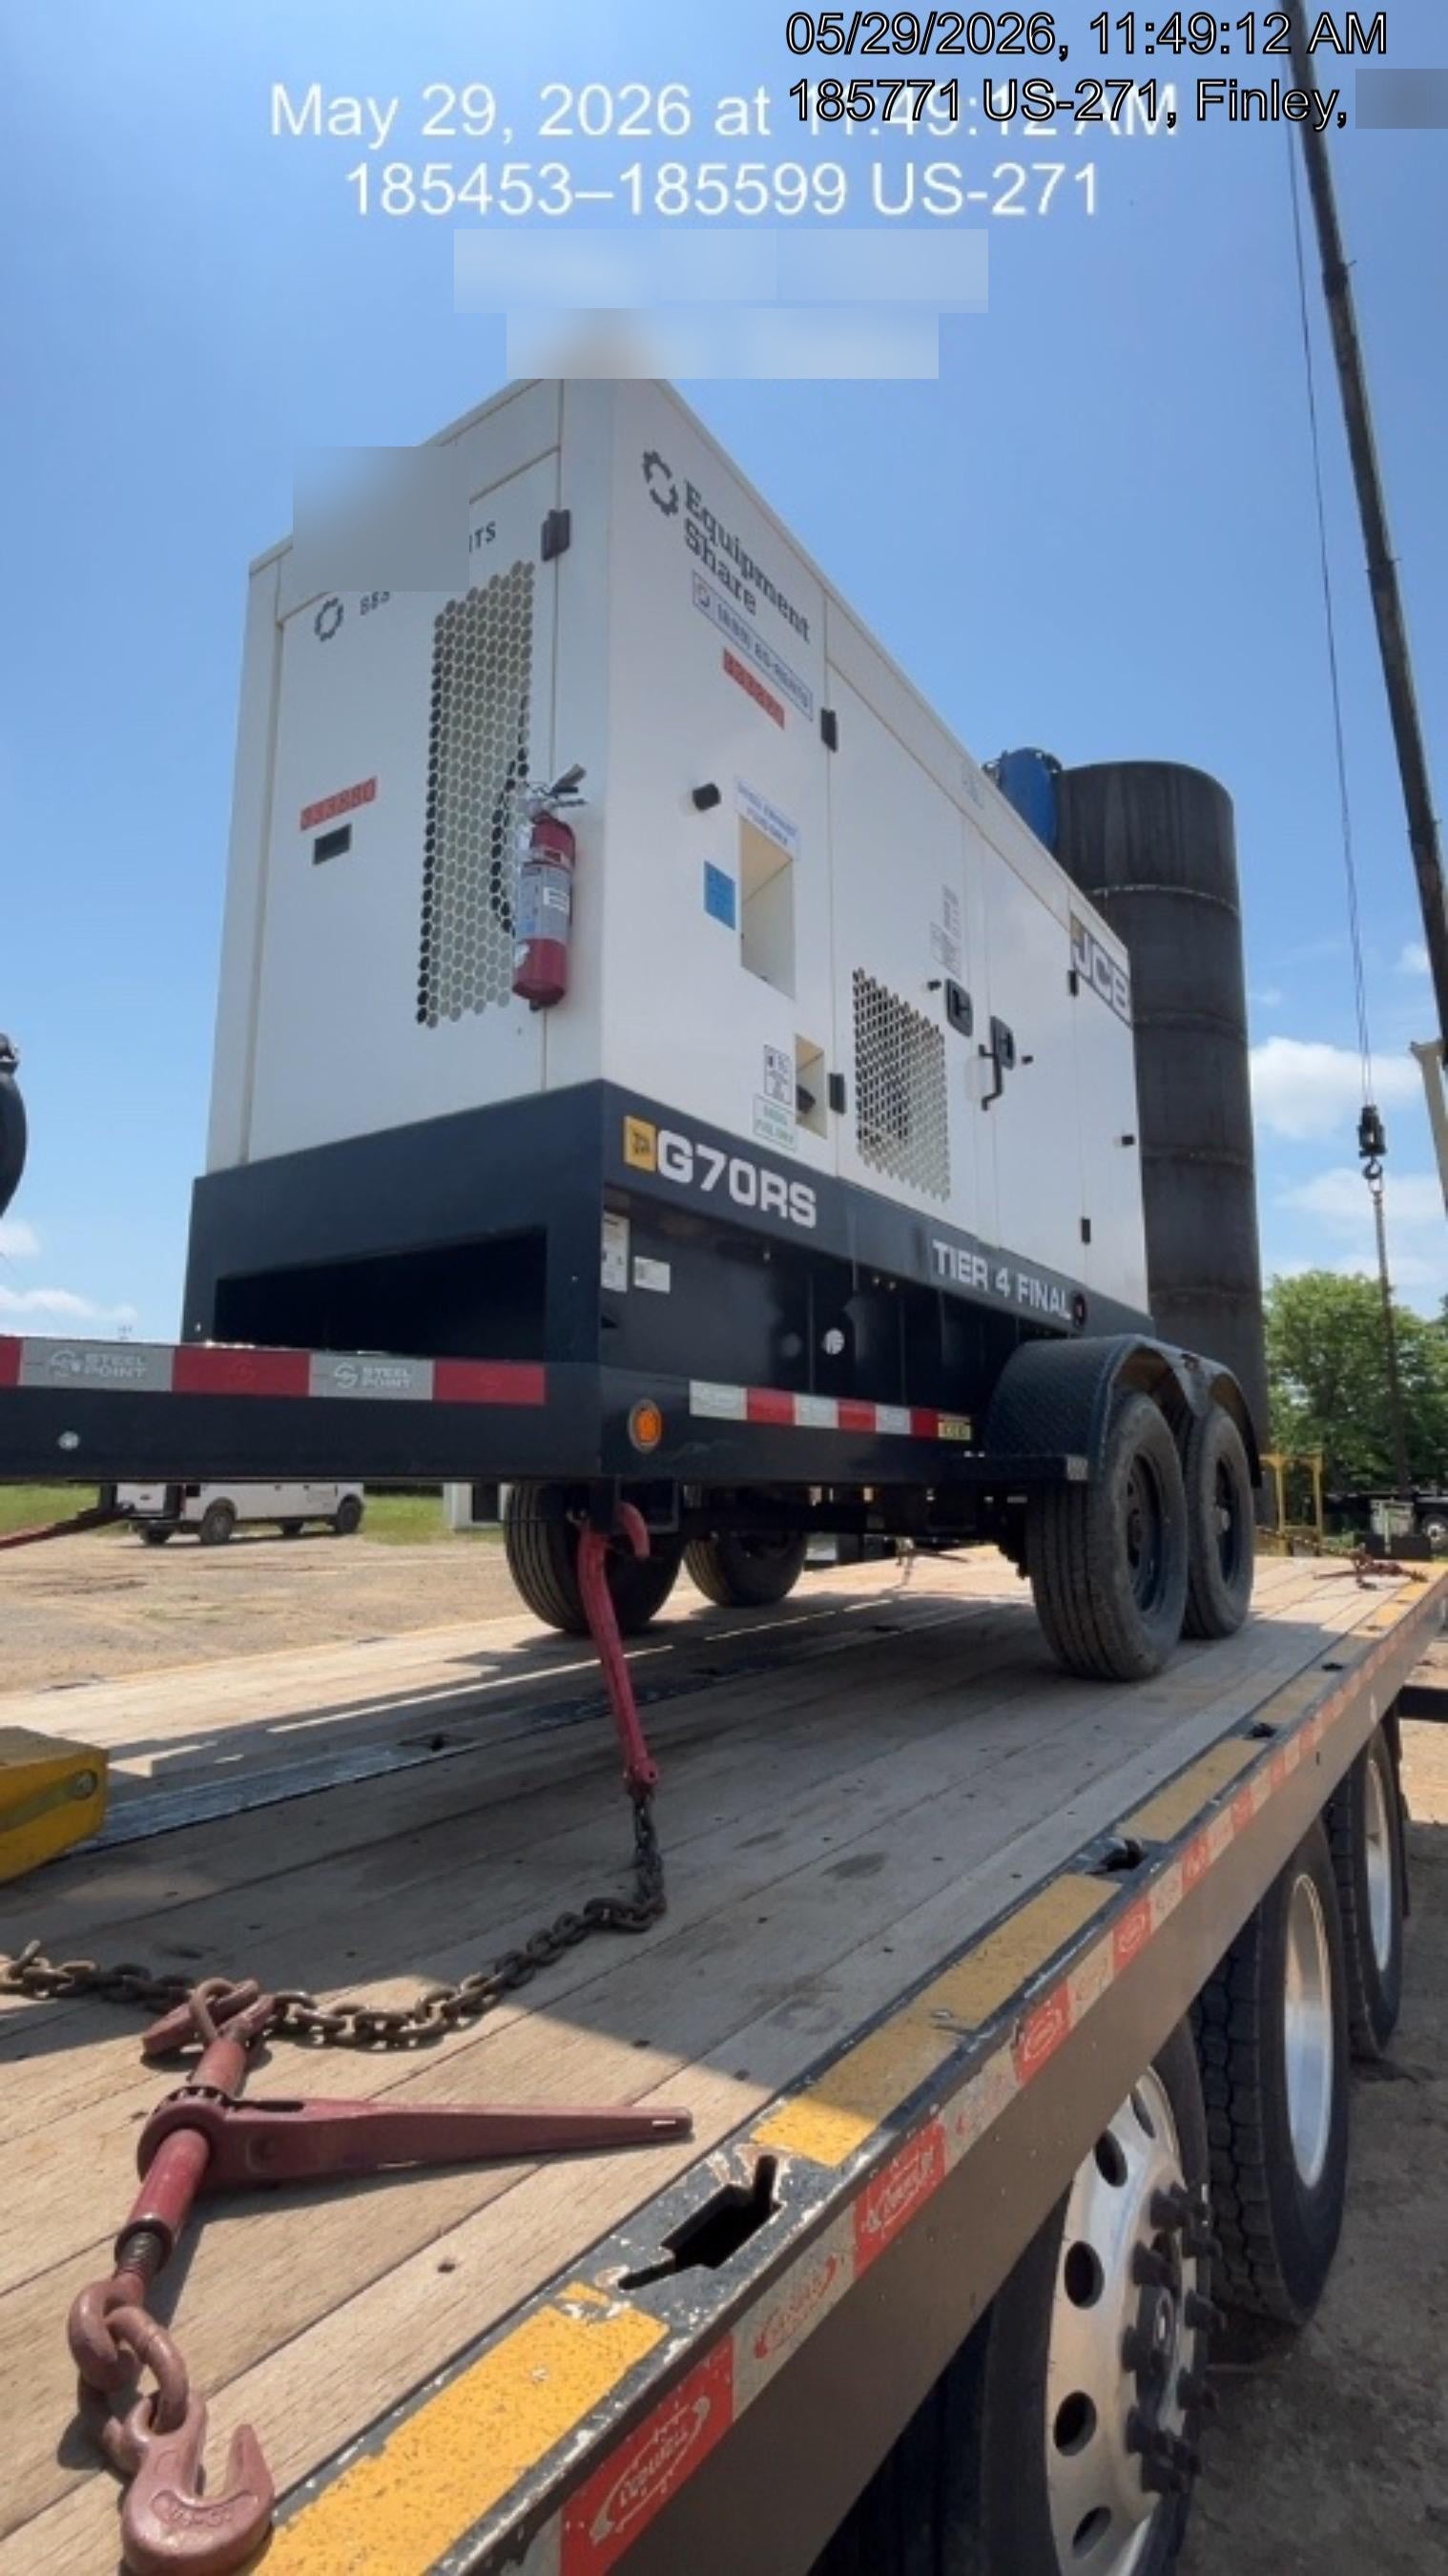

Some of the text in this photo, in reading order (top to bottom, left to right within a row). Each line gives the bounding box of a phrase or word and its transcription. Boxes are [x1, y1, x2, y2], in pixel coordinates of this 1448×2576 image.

[684, 479, 810, 643] Equipment
[684, 516, 757, 617] Share
[1073, 929, 1131, 1023] JCB
[657, 1129, 817, 1229] G70RS
[932, 1239, 1072, 1320] TIER 4 FINAL
[84, 1353, 146, 1366] STEEL
[84, 1364, 147, 1379] POINT
[362, 1366, 411, 1378] STEEL
[362, 1377, 411, 1389] POINT
